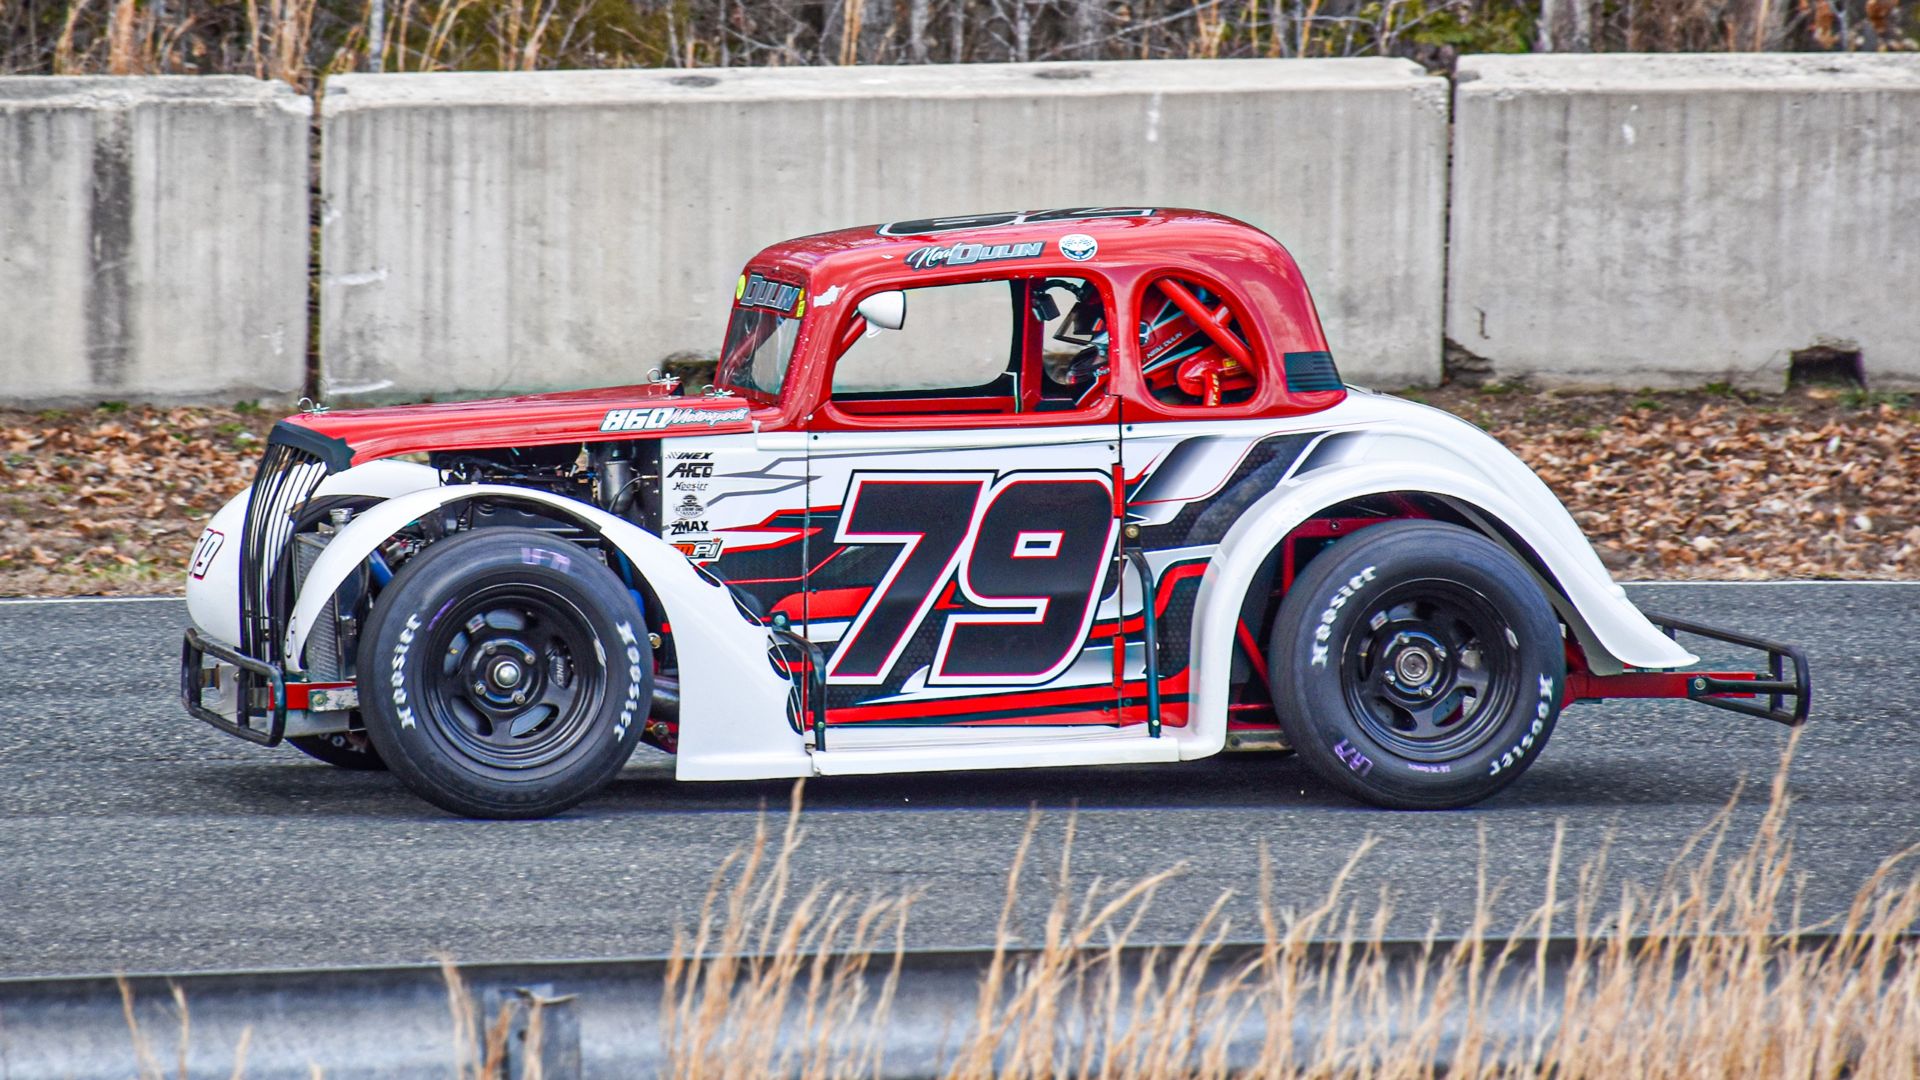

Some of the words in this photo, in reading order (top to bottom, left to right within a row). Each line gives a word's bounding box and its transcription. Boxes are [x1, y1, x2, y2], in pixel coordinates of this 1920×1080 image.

[907, 243, 960, 269] Neal
[946, 242, 1044, 265] DULIN
[740, 273, 801, 312] DULIN
[601, 408, 676, 432] 860
[676, 451, 714, 460] INEX
[666, 462, 714, 478] AFCO
[826, 469, 1119, 688] 79
[1311, 565, 1377, 669] Hoosier
[390, 612, 422, 731] Hoosier
[615, 620, 642, 743] Hoosier
[1488, 672, 1554, 776] Hoosier
